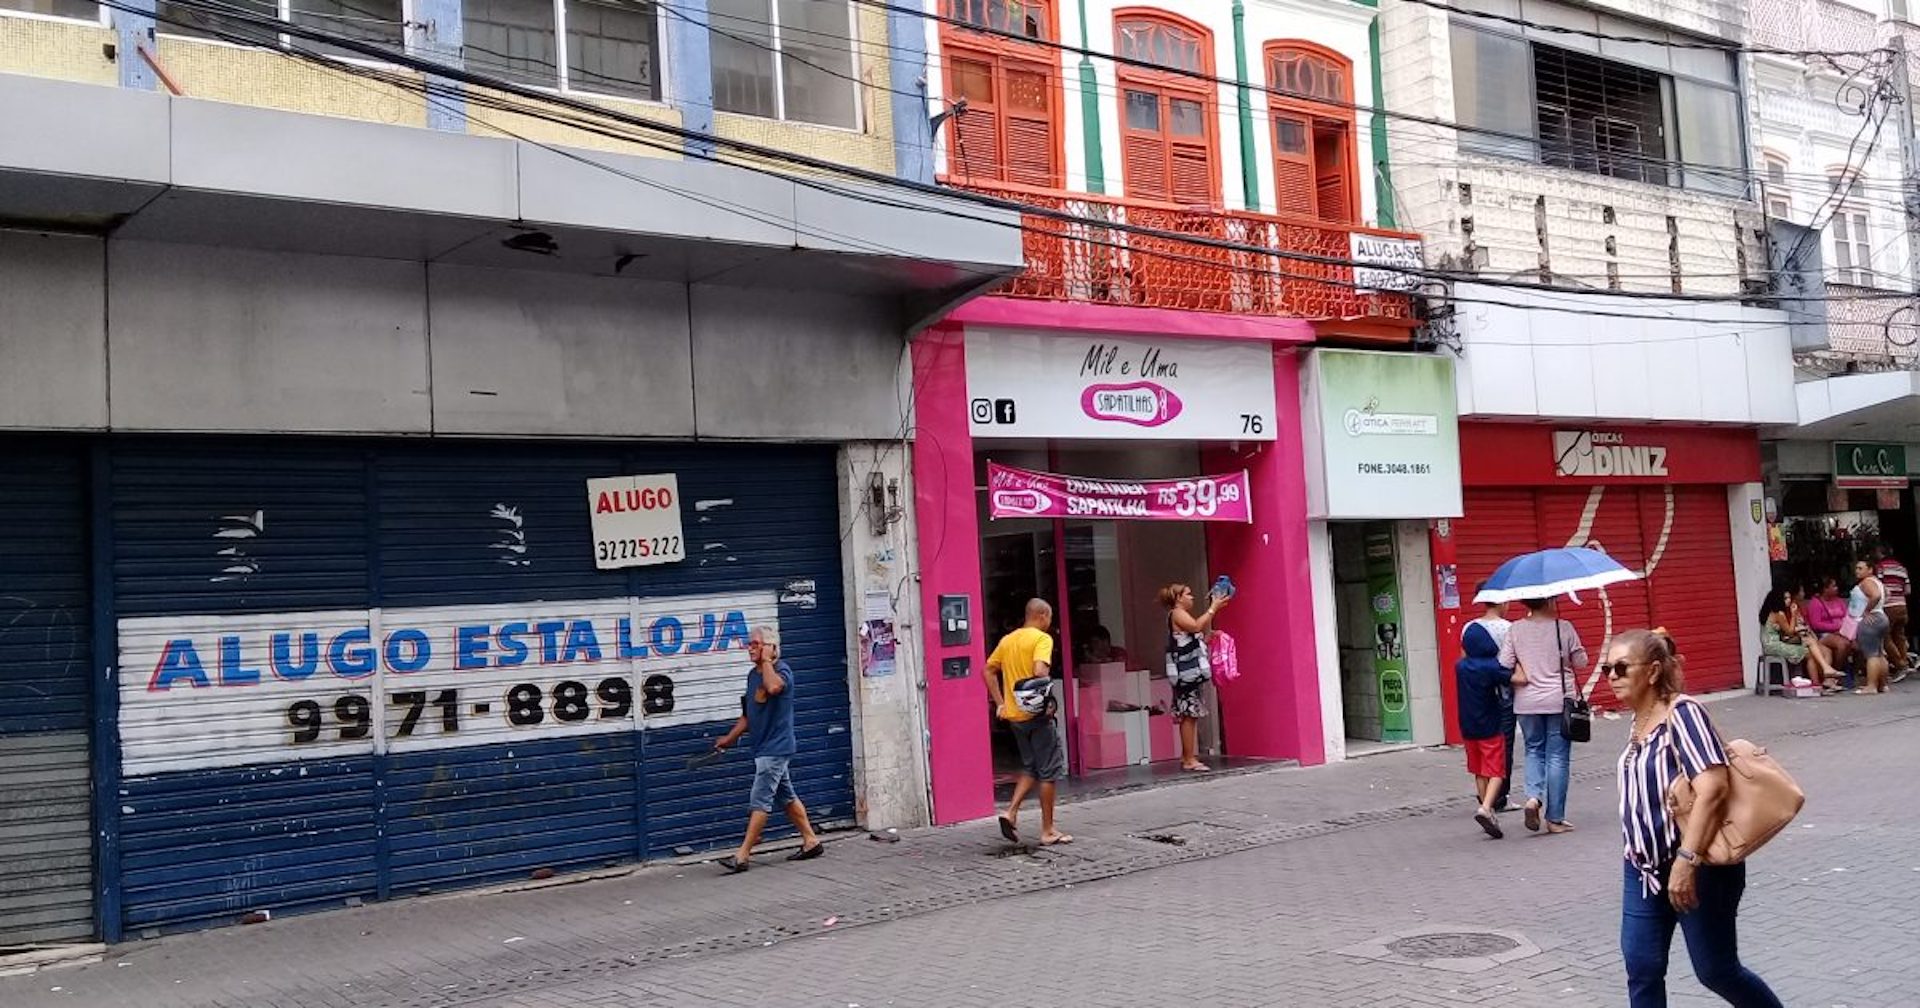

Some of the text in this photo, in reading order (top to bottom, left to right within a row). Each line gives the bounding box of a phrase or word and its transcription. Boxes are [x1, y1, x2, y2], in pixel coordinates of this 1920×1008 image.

[1079, 343, 1179, 378] Mil e Uma
[1098, 393, 1153, 413] SAPATILHAS
[1240, 414, 1263, 434] 76
[1594, 446, 1668, 476] DINIZ
[596, 488, 672, 514] ALUGO
[1066, 496, 1150, 516] SAPATILHA
[598, 535, 679, 560] 32225222
[147, 609, 750, 692] ALUGO ESTA LOJA
